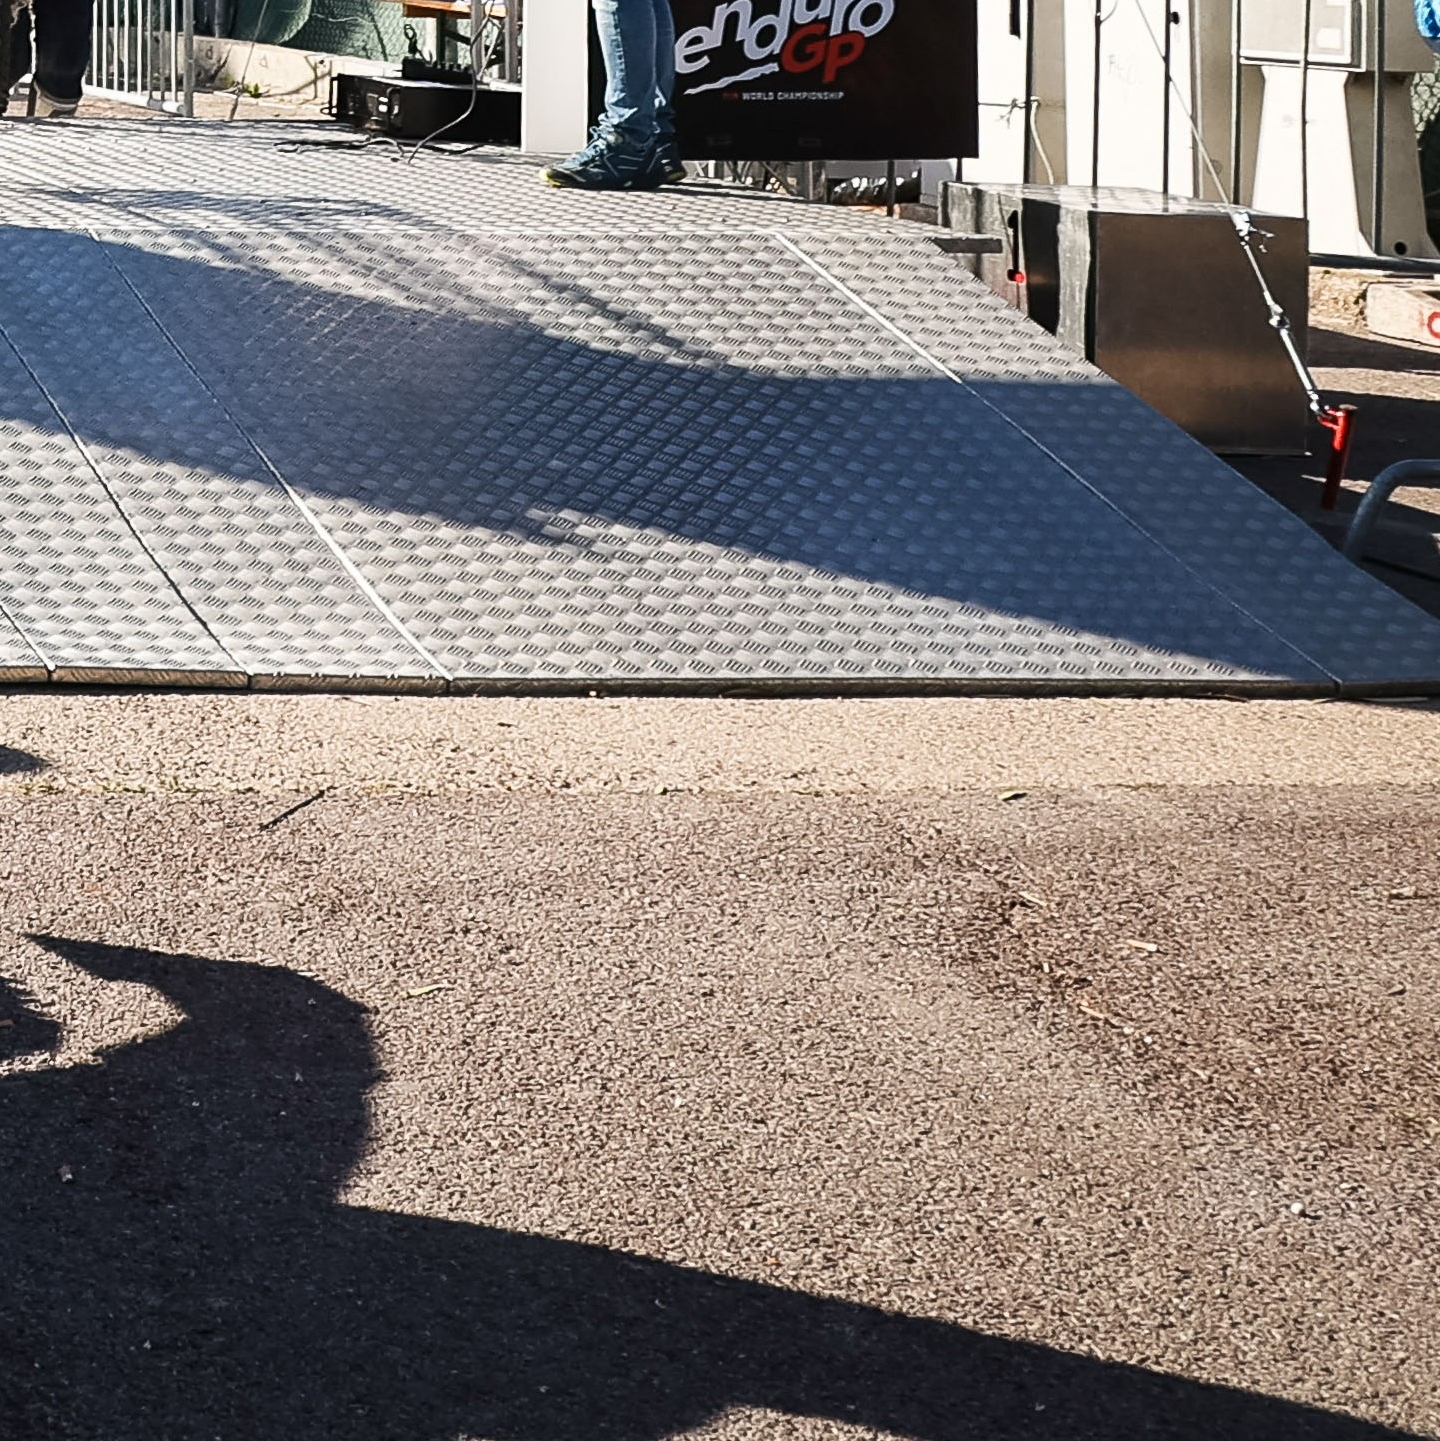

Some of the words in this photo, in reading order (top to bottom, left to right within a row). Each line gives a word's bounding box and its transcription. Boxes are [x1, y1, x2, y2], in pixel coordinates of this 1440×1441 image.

[781, 25, 866, 83] GP
[743, 92, 774, 101] WORLD
[777, 92, 844, 101] CHAMPIONSHIP
